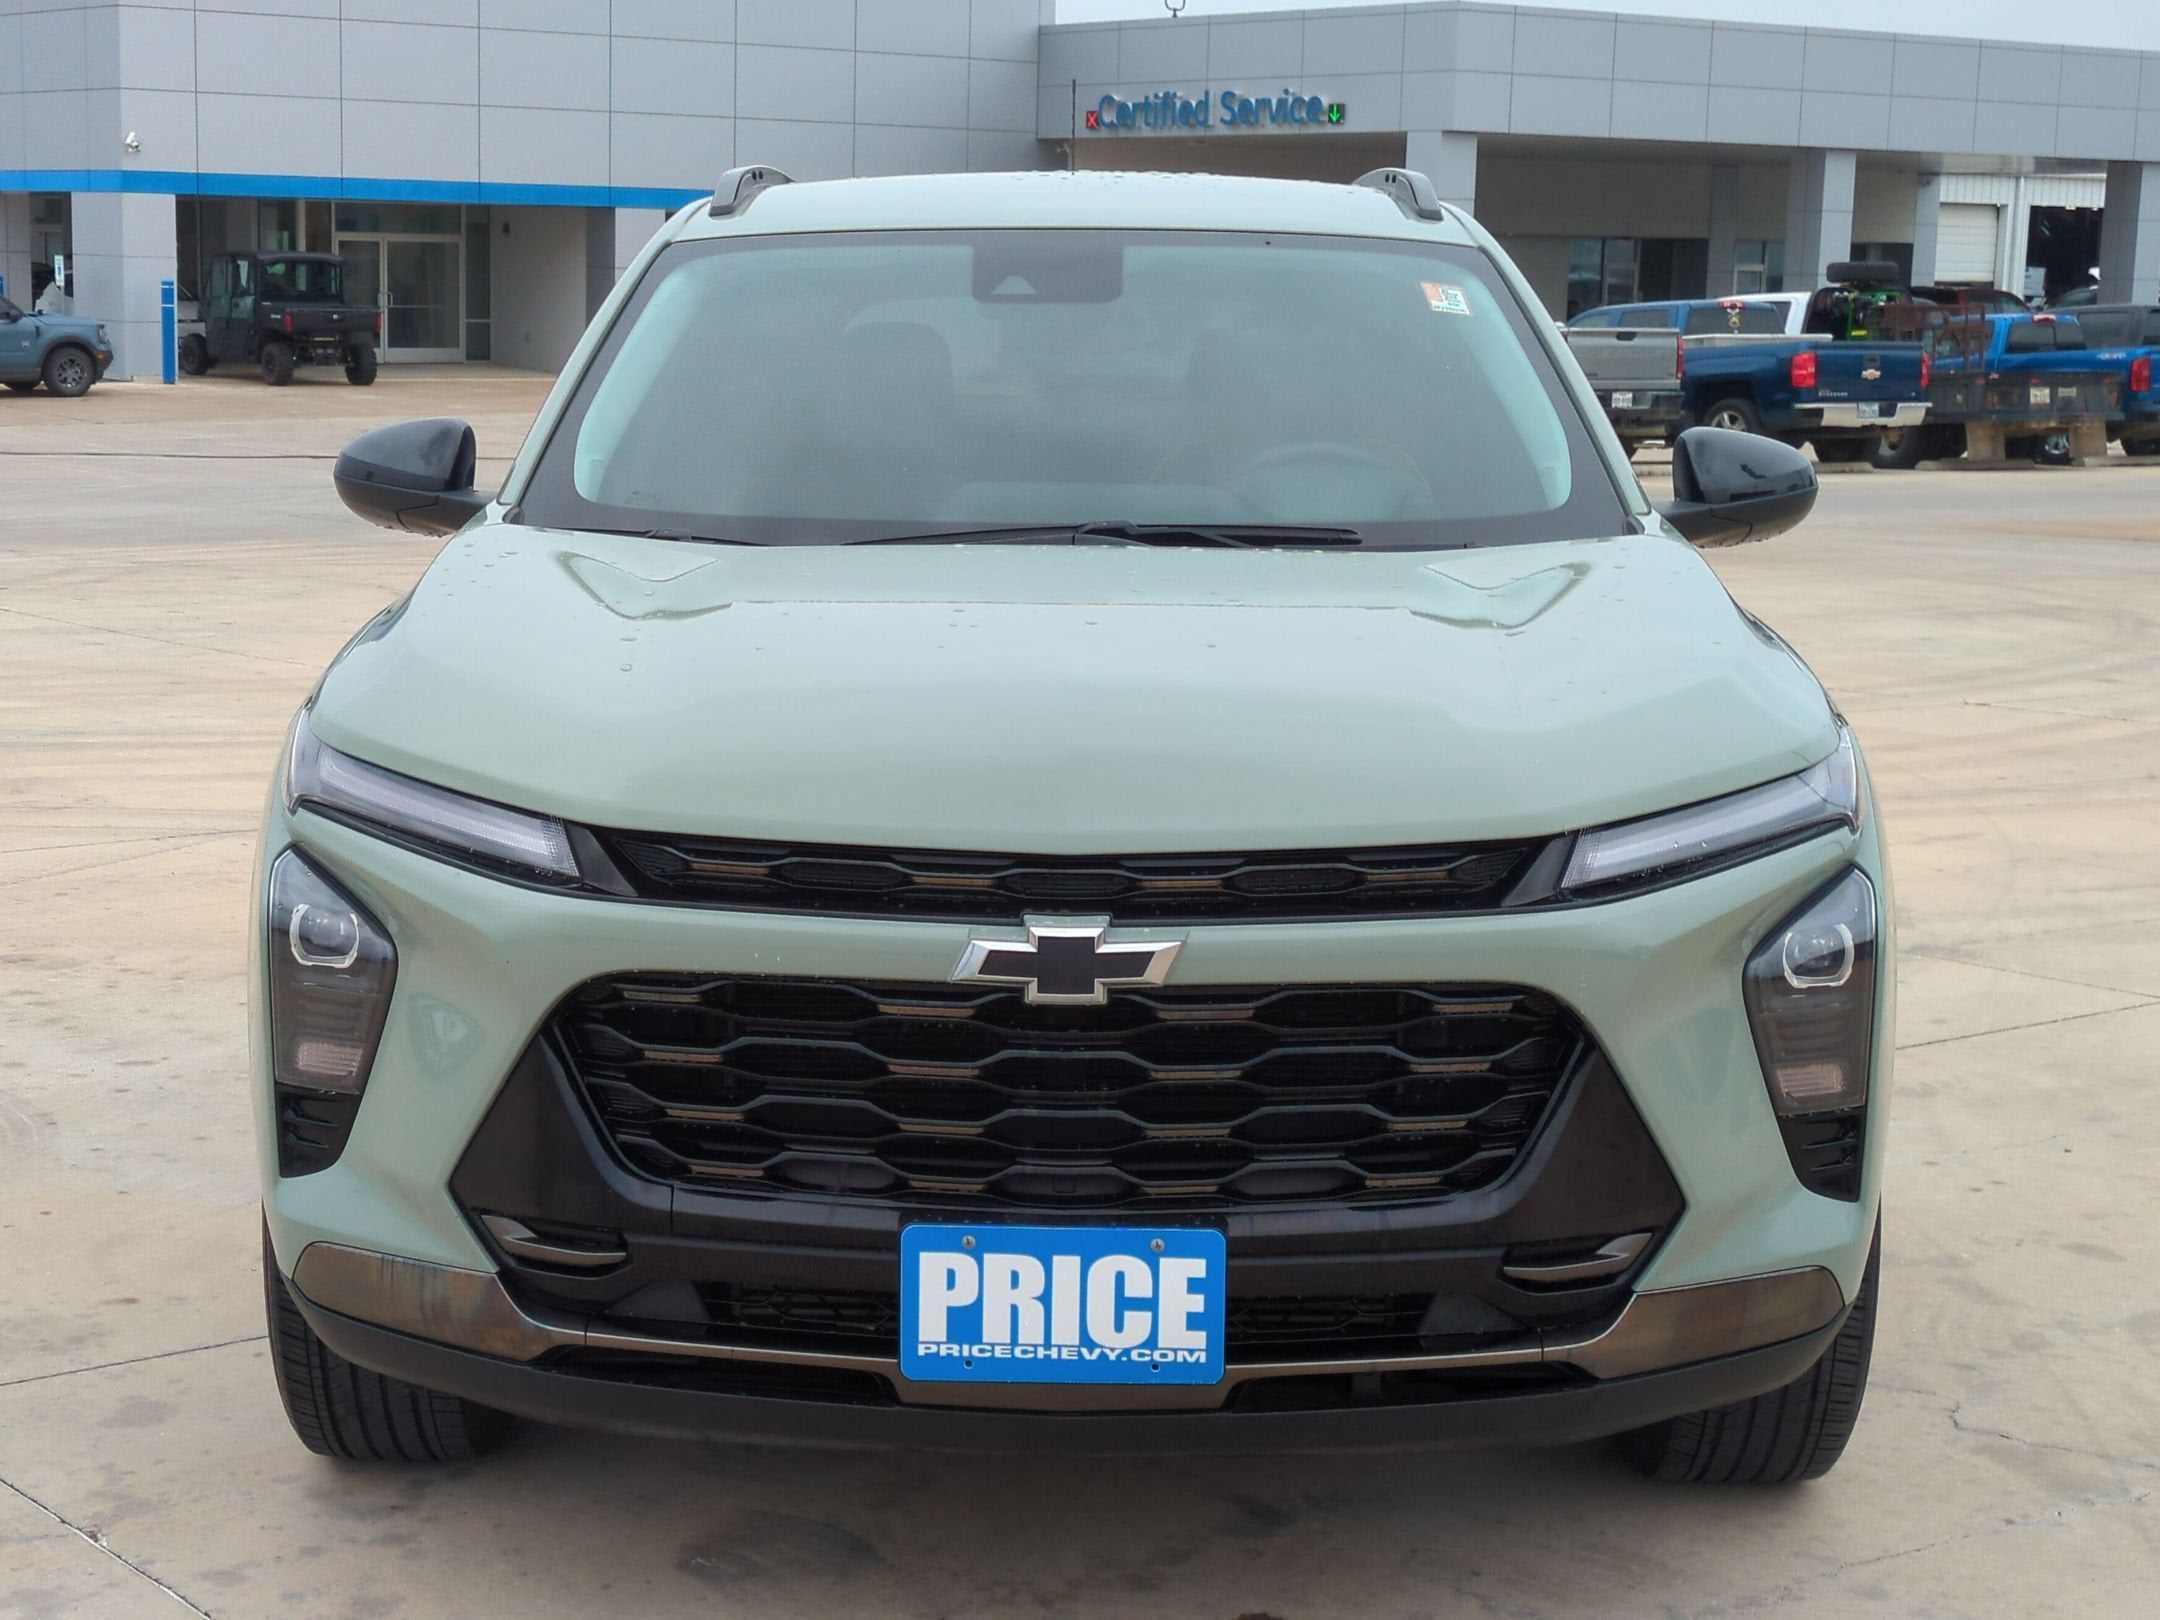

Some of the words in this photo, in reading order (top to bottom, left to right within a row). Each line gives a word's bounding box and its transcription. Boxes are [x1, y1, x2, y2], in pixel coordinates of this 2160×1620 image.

[1098, 90, 1210, 129] Certified
[1219, 88, 1323, 125] Service
[918, 1251, 1207, 1350] PRICE
[917, 1343, 1207, 1364] PRICECHEVY.COM
